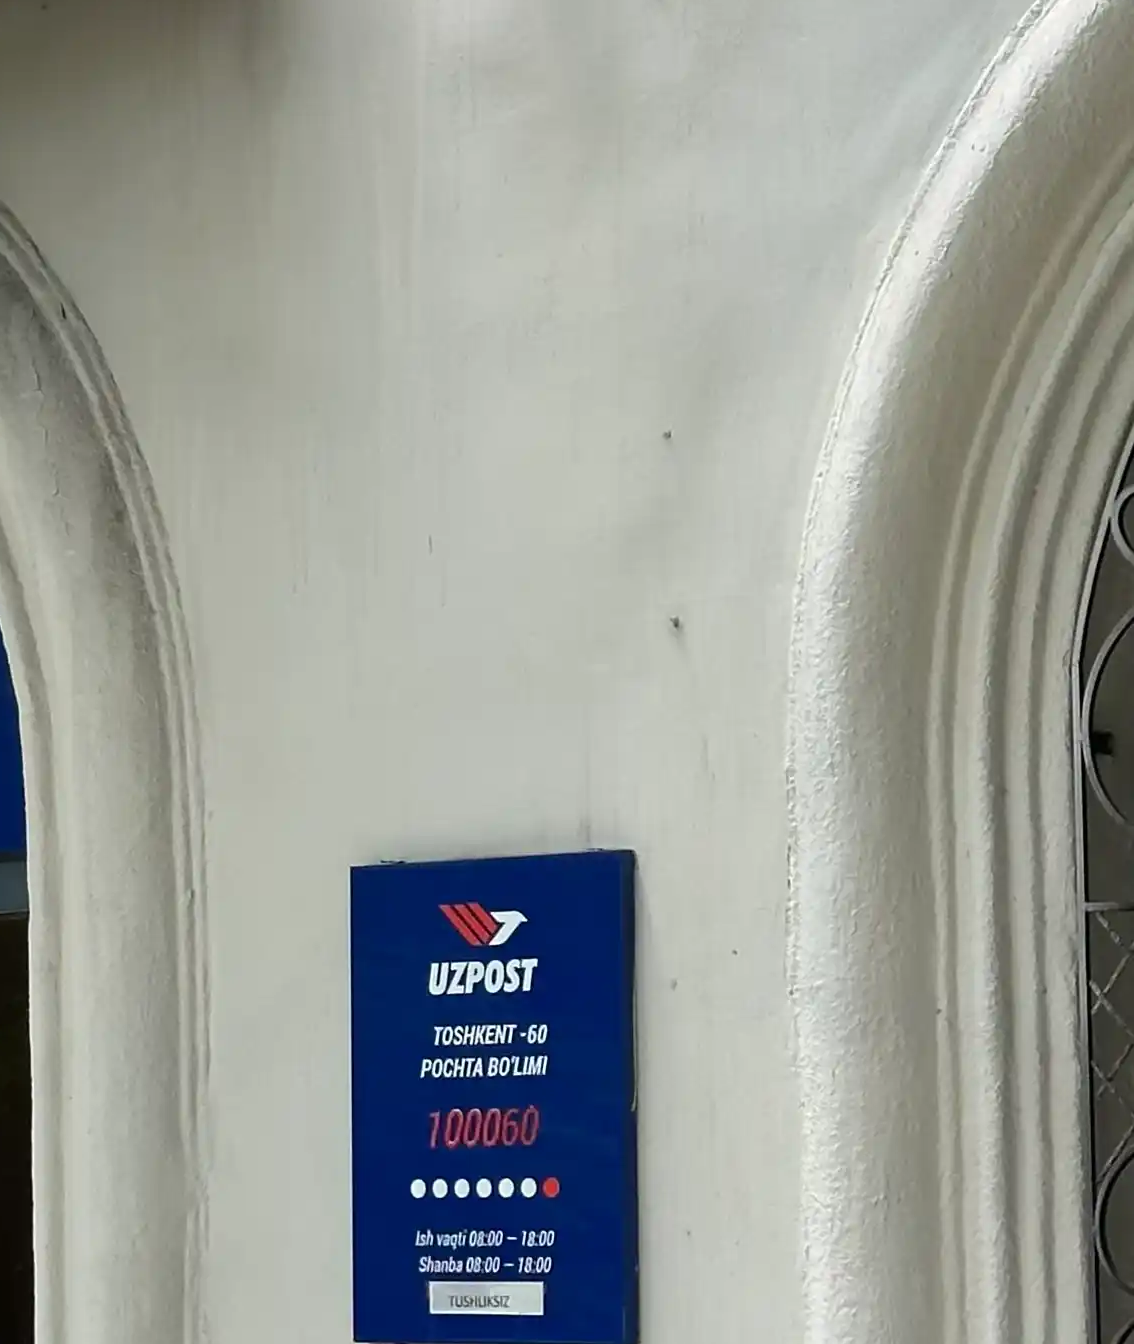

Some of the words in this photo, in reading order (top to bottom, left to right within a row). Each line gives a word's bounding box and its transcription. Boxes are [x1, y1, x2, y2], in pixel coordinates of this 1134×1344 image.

[428, 958, 538, 995] UZPOST
[433, 1024, 518, 1046] TOSHKENT
[519, 1024, 548, 1044] -60
[420, 1057, 484, 1078] POCHTA
[429, 1105, 540, 1149] 100060
[415, 1229, 434, 1247] Ish
[436, 1229, 467, 1250] vaqti
[468, 1229, 503, 1248] 08:00
[521, 1229, 556, 1248] 18:00
[418, 1256, 463, 1274] Shanba
[465, 1256, 501, 1274] 08:00
[517, 1256, 553, 1274] 18:00
